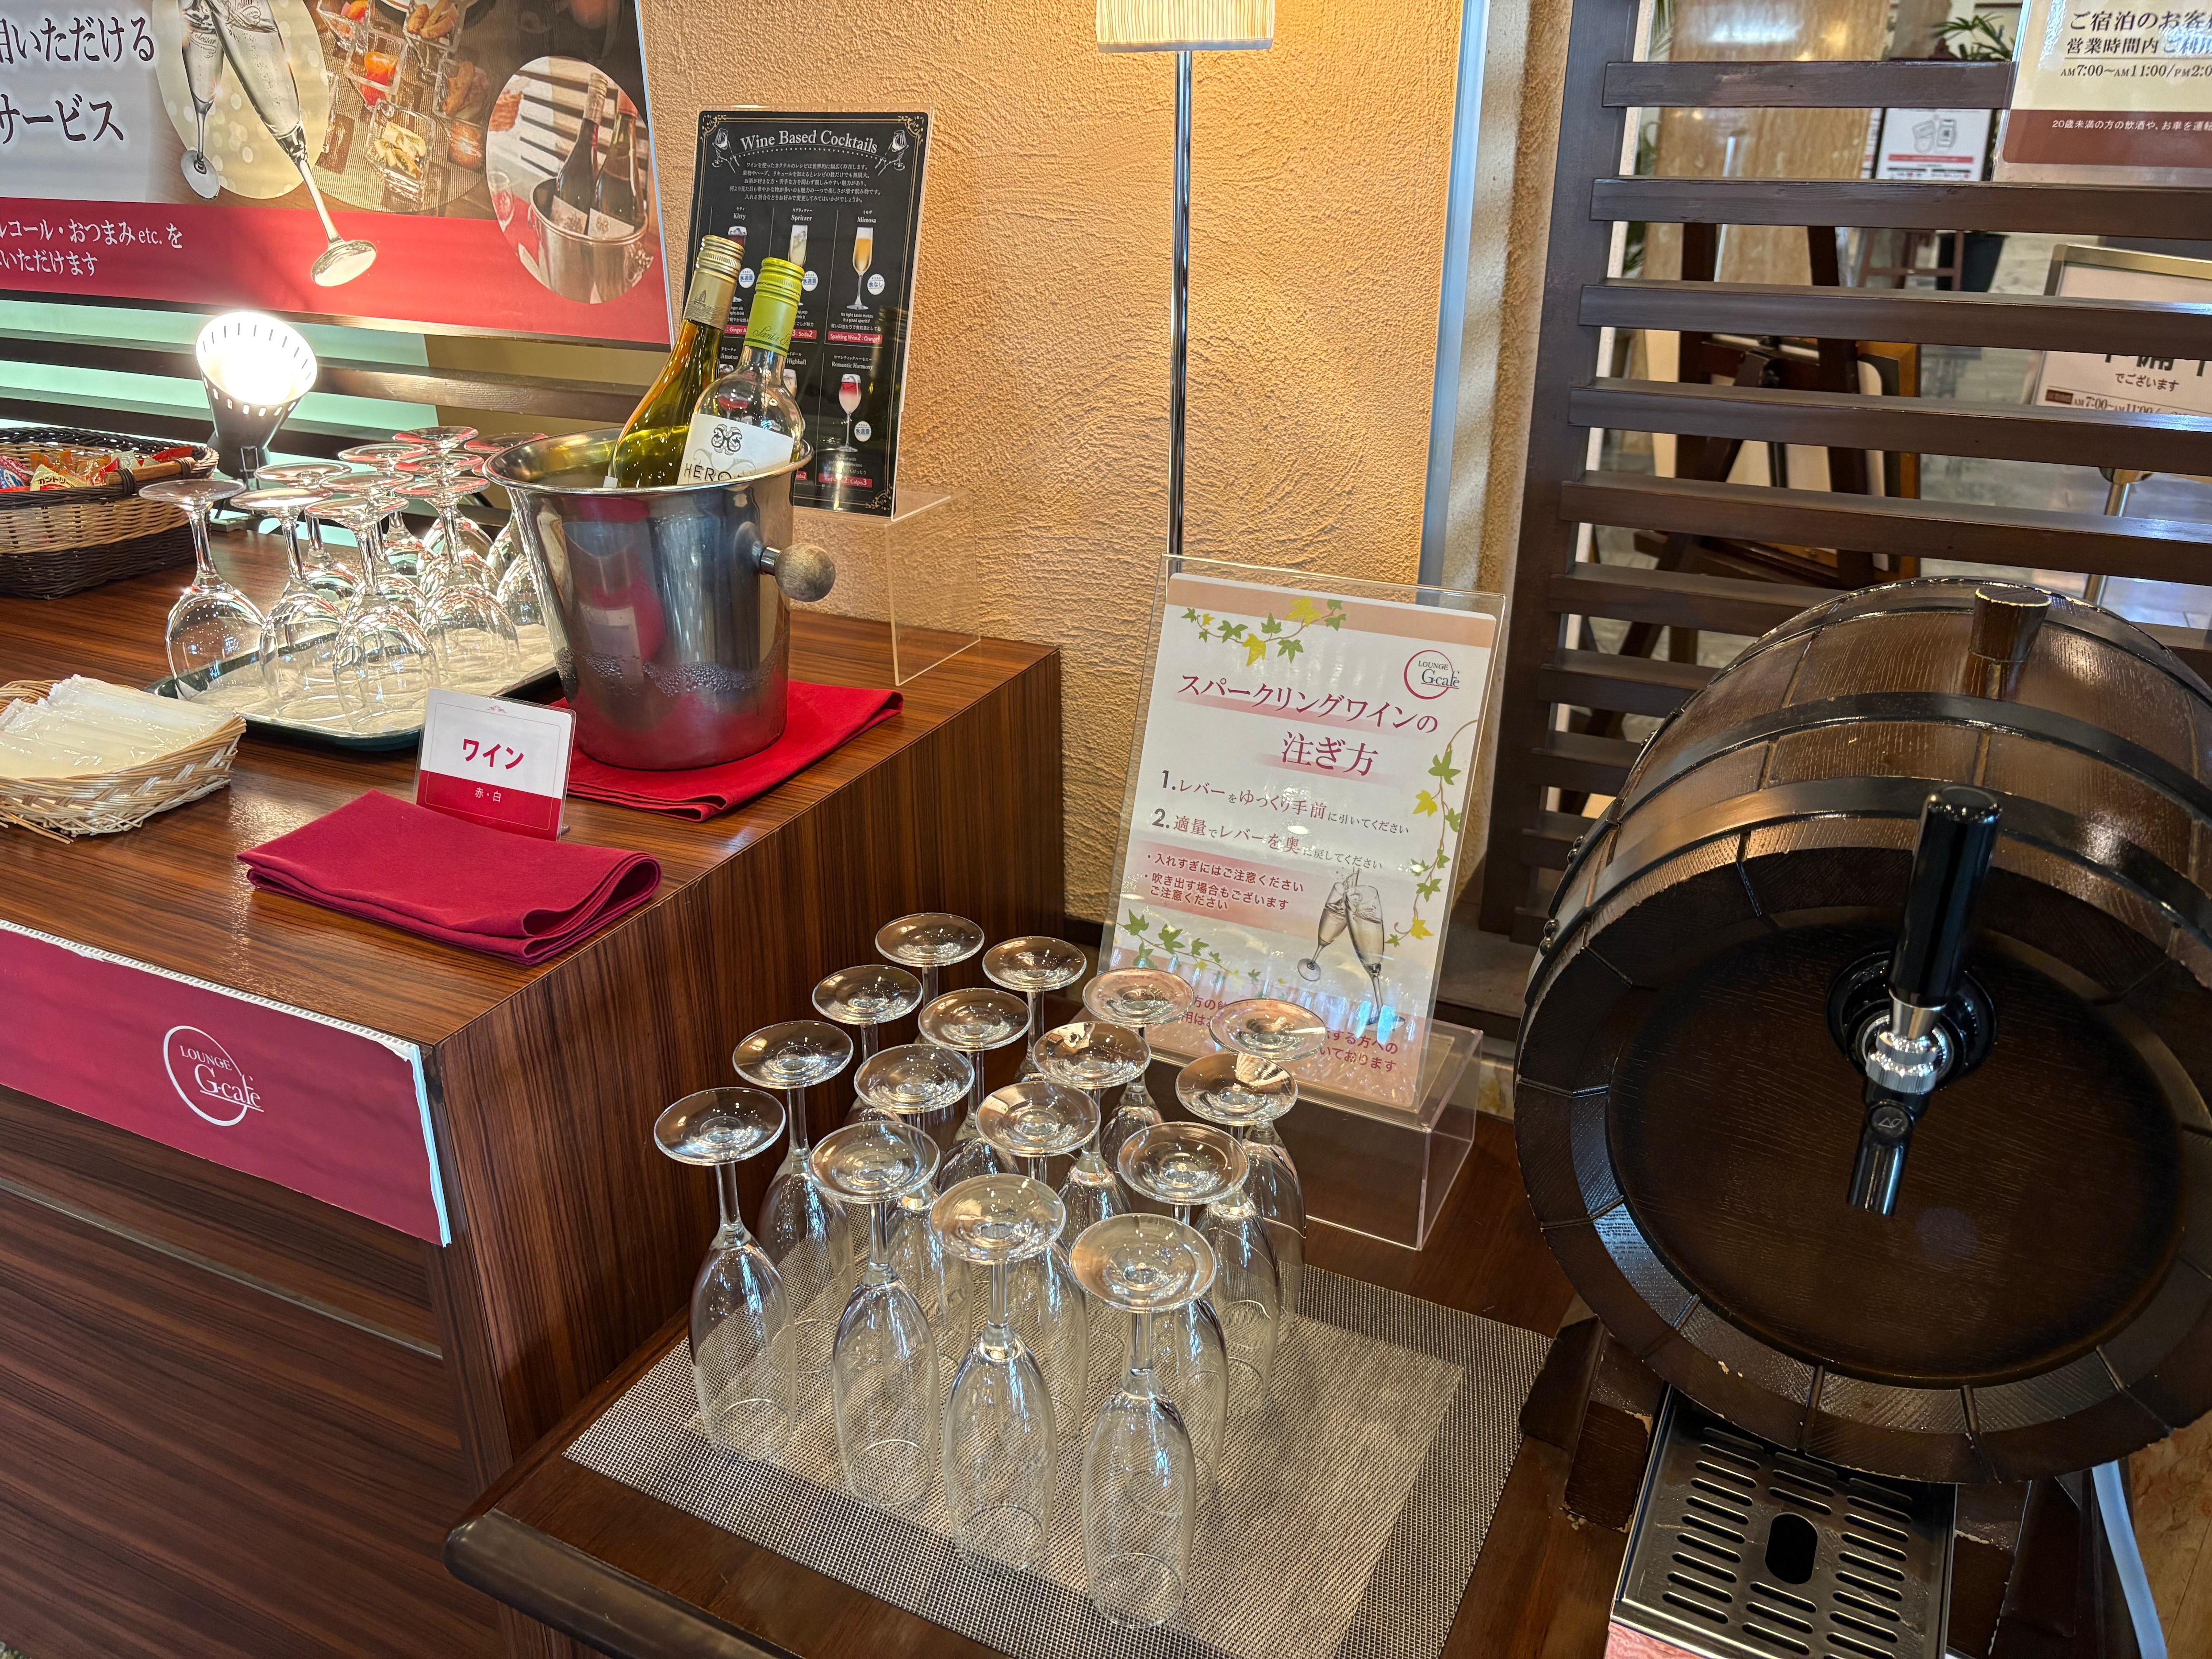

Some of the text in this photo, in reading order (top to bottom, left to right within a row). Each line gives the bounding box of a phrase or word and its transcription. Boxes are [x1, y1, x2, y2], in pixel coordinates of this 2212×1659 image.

[2070, 10, 2212, 31] ご宿泊のお客
[0, 93, 123, 144] サービス
[740, 130, 878, 154] Wine Based Cocktails
[0, 248, 98, 276] いただけます
[2115, 373, 2179, 392] でございます
[684, 463, 743, 481] HERO
[1418, 661, 1448, 670] LOUNGE
[1177, 675, 1438, 733] スパークリングワインの
[463, 738, 524, 770] ワイン
[1282, 731, 1379, 776] 注ぎ方
[475, 787, 502, 803] 赤・白
[1150, 886, 1228, 910] ご注意ください
[180, 1045, 232, 1071] LOUNGE
